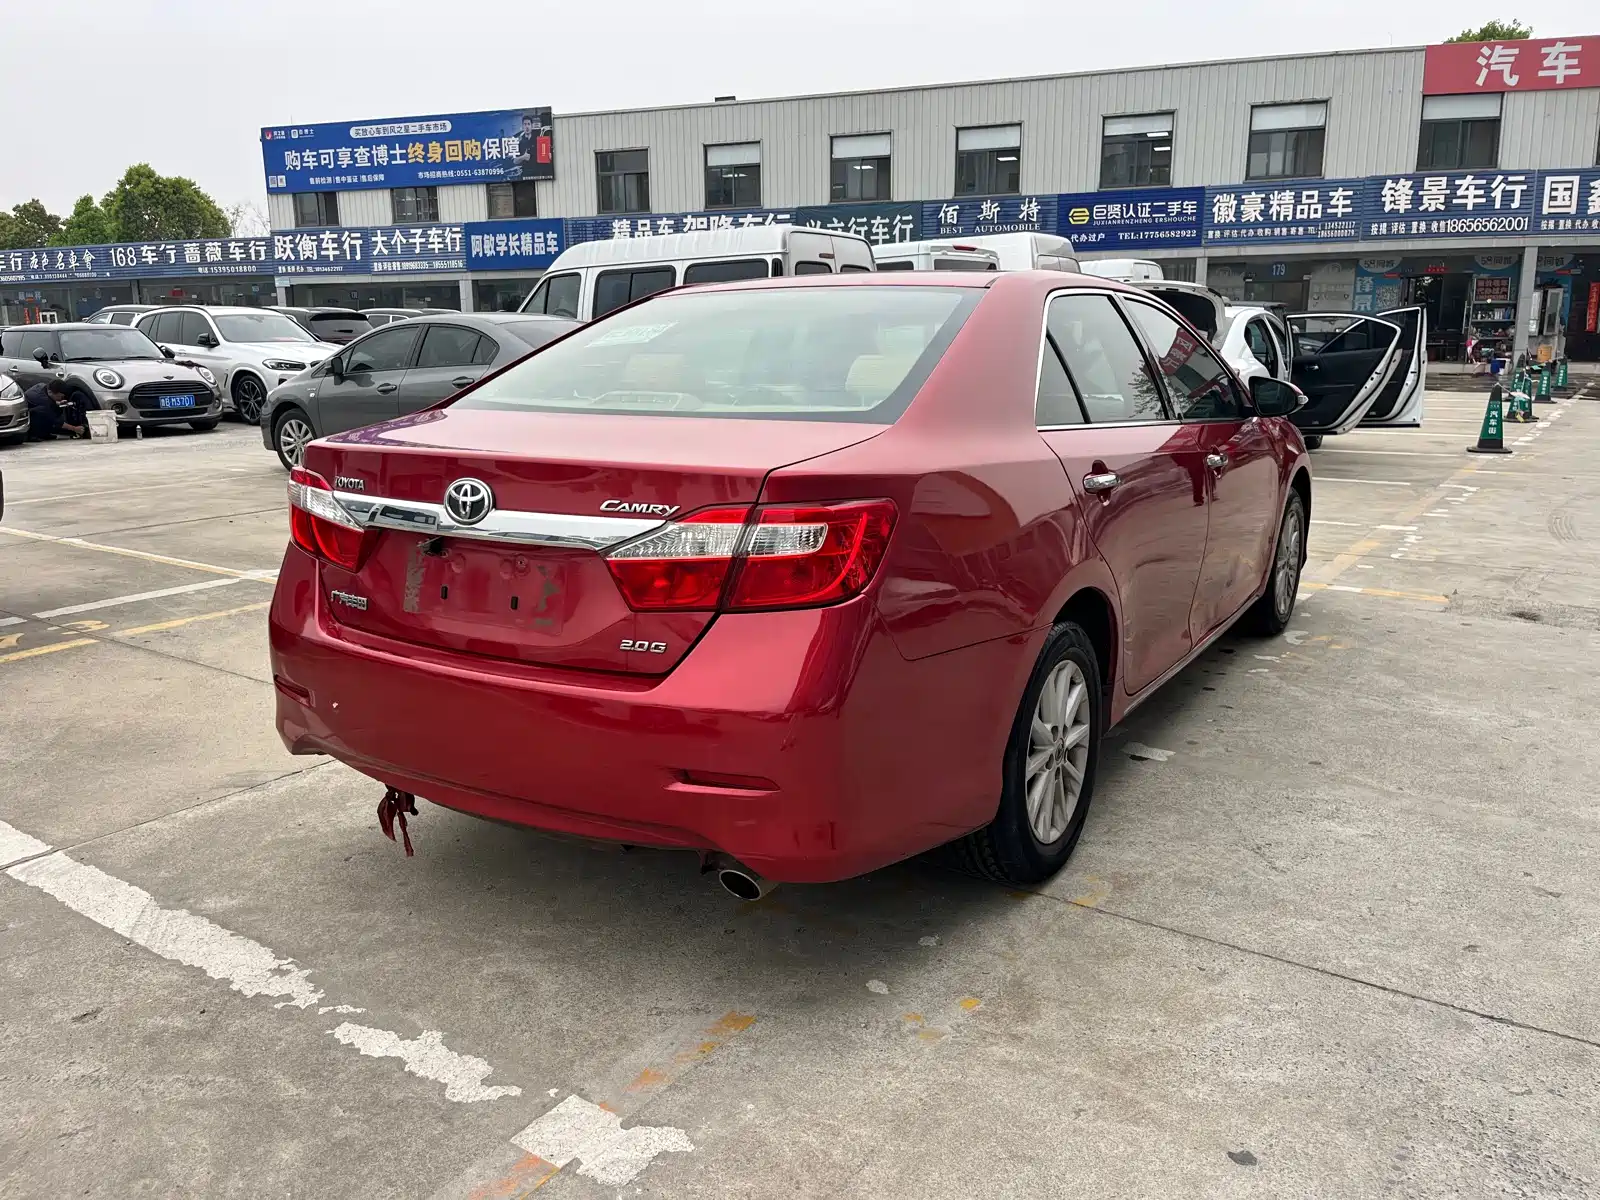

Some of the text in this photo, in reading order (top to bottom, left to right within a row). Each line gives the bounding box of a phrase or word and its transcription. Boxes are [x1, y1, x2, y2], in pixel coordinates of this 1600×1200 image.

[1475, 41, 1582, 87] 汽车
[354, 123, 447, 137] 买放心车到风之星二手车市场
[285, 136, 521, 171] 购车可享查博士终身回购保障
[1381, 174, 1528, 213] 锋景车行
[1093, 200, 1197, 219] 巨贤认证二手车
[1212, 187, 1354, 223] 徽豪精品车
[940, 223, 1041, 235] BEST AUTOMOBILE
[1092, 215, 1196, 226] JUXIANRENZHENG ERSHOUCHE
[1370, 222, 1387, 235] 按揭
[1391, 222, 1406, 234] 评估
[1411, 221, 1426, 233] 置换
[1446, 216, 1529, 233] 18656562001
[372, 226, 463, 257] 大个子车行
[1070, 230, 1197, 243] 代办过户 TEL:17756582922
[1223, 229, 1238, 238] 评估
[1240, 228, 1254, 237] 代办
[183, 240, 267, 263] 蔷薇车行
[274, 230, 363, 261] 跃衡车行
[471, 231, 558, 258] 阿敏学长精品车
[1272, 263, 1286, 276] 179
[335, 476, 364, 491] TOYOTA
[600, 500, 680, 517] CAMRY
